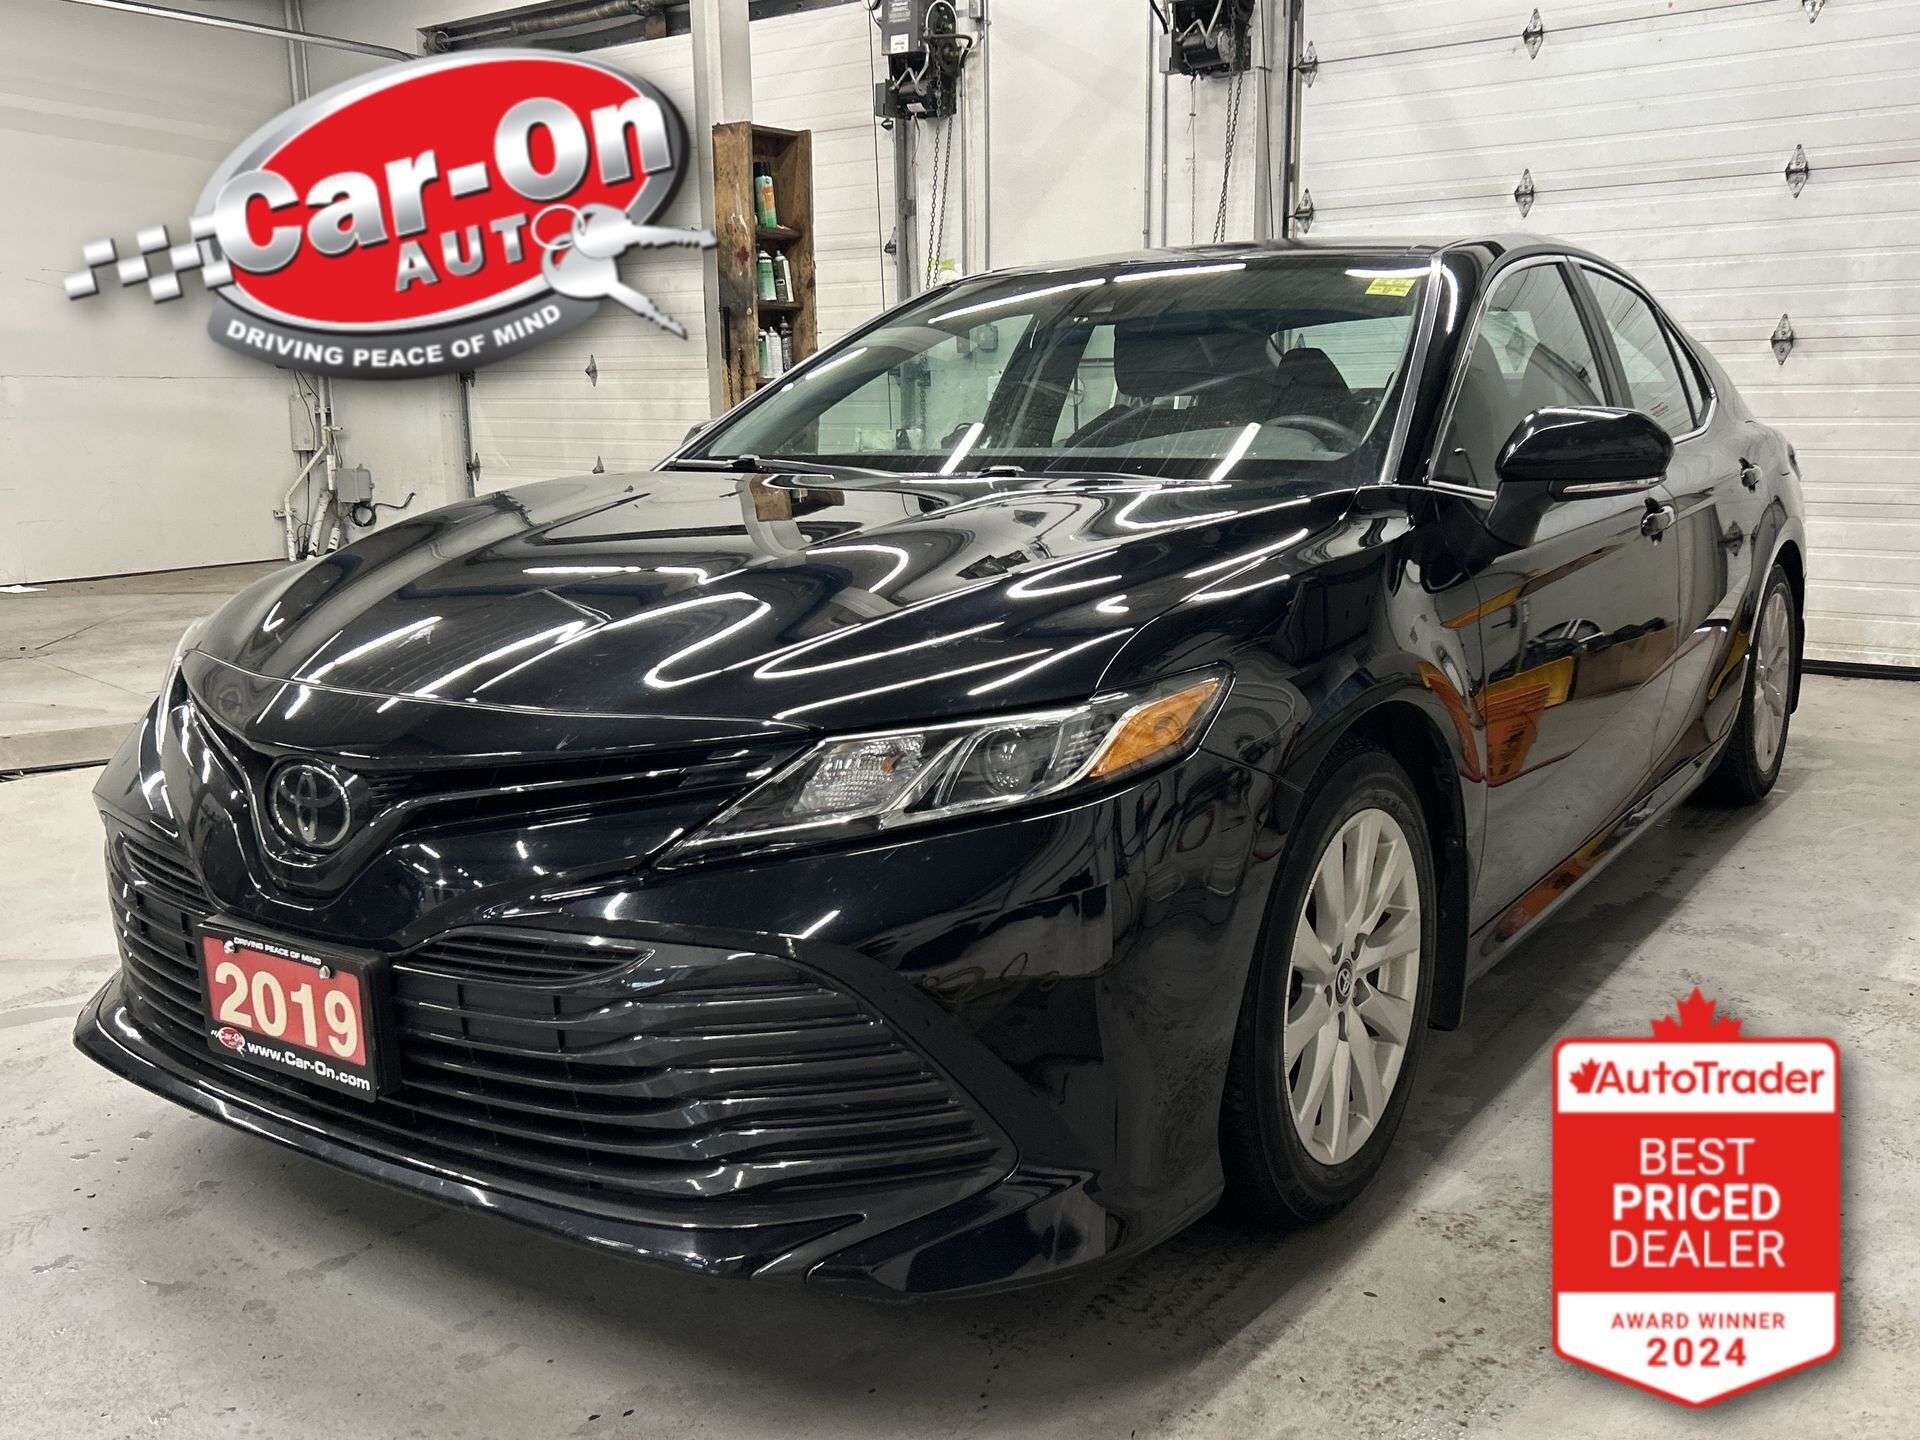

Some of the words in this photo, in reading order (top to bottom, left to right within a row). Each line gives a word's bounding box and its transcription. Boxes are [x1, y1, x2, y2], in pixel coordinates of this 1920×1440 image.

[233, 937, 264, 951] DRIVING
[264, 944, 289, 957] PEACE
[215, 962, 358, 1058] 2019
[247, 1041, 371, 1091] www.Car-On.com
